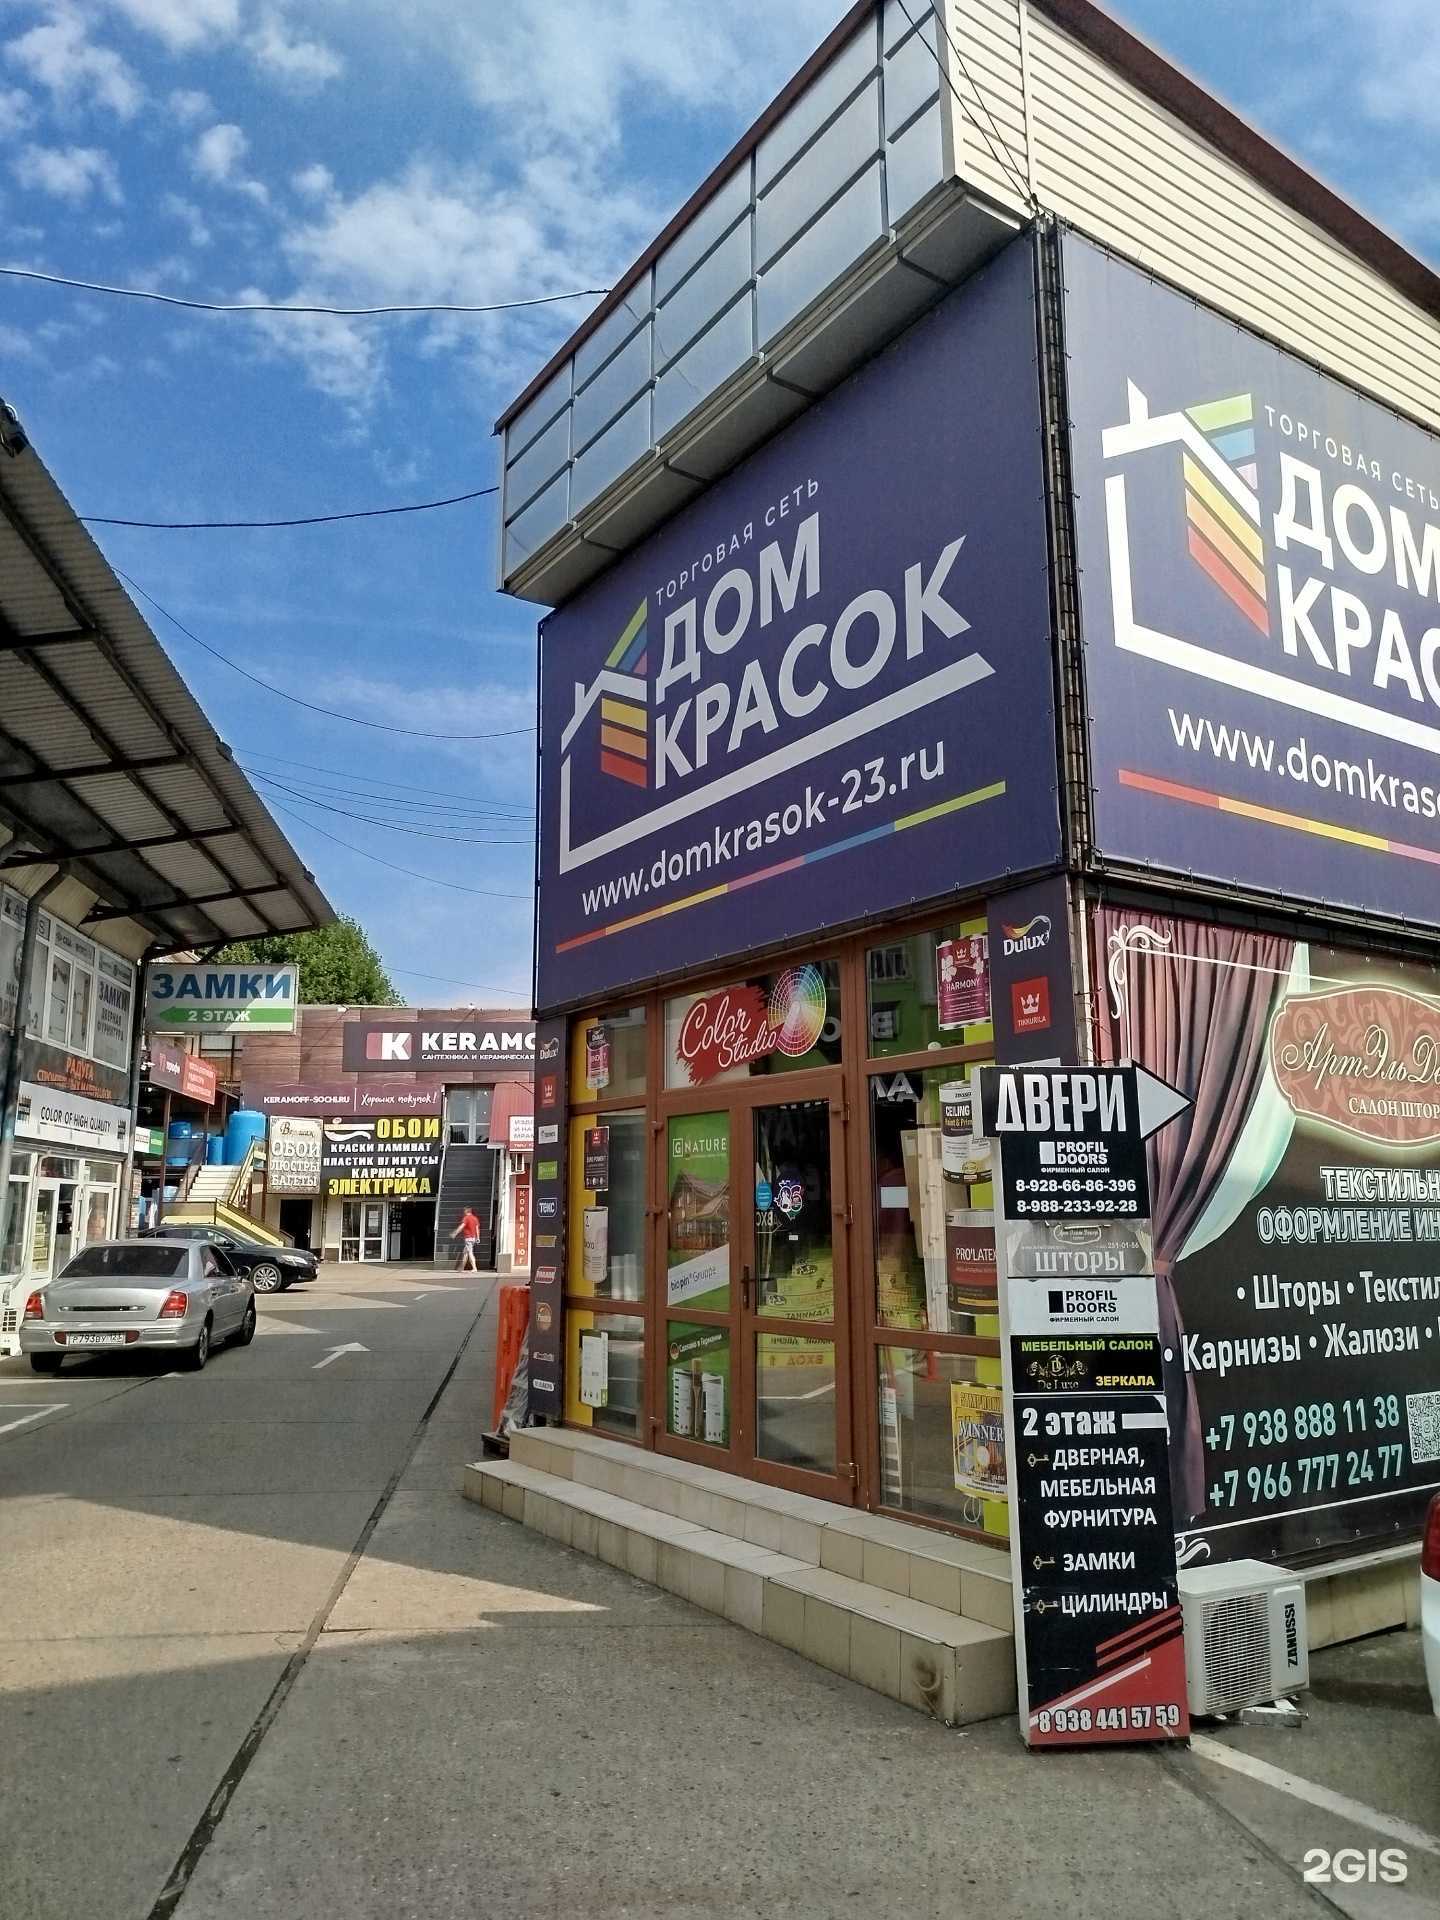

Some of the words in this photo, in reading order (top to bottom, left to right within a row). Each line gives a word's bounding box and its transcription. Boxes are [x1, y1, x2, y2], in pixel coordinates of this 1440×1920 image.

[1264, 405, 1381, 482] ТОРГОВАЯ
[1391, 471, 1440, 510] СЕТЬ
[655, 521, 753, 606] ТОРГОВАЯ
[764, 478, 819, 527] СЕТЬ
[656, 511, 821, 705] ДОМ
[655, 534, 972, 790] КРАСОК
[581, 740, 945, 916] www.domkrasok-23.ru
[1003, 935, 1047, 956] Dulux
[151, 973, 291, 999] ЗАМКИ
[945, 977, 981, 992] HARMONY
[98, 980, 129, 1012] ЗАМКИ
[187, 1010, 198, 1022] 2
[202, 1010, 251, 1022] ЭТАЖ
[681, 995, 752, 1058] Color
[1017, 1015, 1047, 1027] TIKKURILA
[717, 1019, 778, 1068] Studio
[66, 1056, 95, 1080] РАДУГА
[263, 1096, 350, 1104] KERAMOFF-SOCHI.RU
[360, 1093, 395, 1106] Хороших
[397, 1093, 438, 1108] покупок!
[995, 1073, 1127, 1133] ДВЕРИ
[1349, 1097, 1398, 1117] САЛОН
[40, 1106, 62, 1122] COLOR
[64, 1110, 73, 1124] OF
[74, 1113, 88, 1128] HIGH
[89, 1116, 111, 1133] QUALITY
[945, 1105, 970, 1117] CEILING
[377, 1117, 440, 1139] ОБОИ
[271, 1139, 321, 1158] ОБОИ
[330, 1143, 375, 1153] КРАСКИ
[377, 1142, 431, 1152] ЛАМИНАТ
[684, 1137, 727, 1152] NATURE
[1056, 1141, 1109, 1153] PROFIL
[271, 1159, 321, 1172] ЛЮСТРЫ
[323, 1156, 374, 1167] ПЛАСТИК
[1056, 1152, 1108, 1165] DOORS
[271, 1175, 317, 1186] БАГЕТЫ
[351, 1167, 416, 1179] КАРНИЗЫ
[1040, 1166, 1086, 1174] ФИРМЕННЫЙ
[328, 1177, 431, 1196] ЭЛЕКТРИКА
[1015, 1178, 1137, 1193] 8-928-66-86-396
[1016, 1199, 1138, 1213] 8-988-233-92-28
[1257, 1206, 1414, 1244] ОФОРМЛЕНИЕ
[1034, 1250, 1125, 1274] ШТОРЫ
[1065, 1290, 1118, 1301] PROFIL
[1253, 1274, 1341, 1315] Шторы
[1066, 1301, 1117, 1314] DOORS
[1049, 1315, 1096, 1324] ФИРМЕННЫЙ
[1097, 1315, 1120, 1323] САЛОН
[1021, 1339, 1105, 1352] МЕБЕЛЬНЫЙ
[1108, 1340, 1154, 1350] САЛОН
[1182, 1334, 1301, 1377] Карнизы
[1322, 1323, 1419, 1358] Жалюзи
[1095, 1375, 1156, 1387] ЗЕРКАЛА
[959, 1420, 1005, 1442] WINNER
[1022, 1407, 1039, 1437] 2
[1044, 1409, 1117, 1437] этаж
[1205, 1414, 1236, 1451] +7
[1242, 1408, 1288, 1448] 938
[1294, 1402, 1337, 1440] 888
[1342, 1398, 1367, 1433] 11
[1373, 1394, 1400, 1429] 38
[1052, 1447, 1146, 1471] ДВЕРНАЯ,
[1209, 1469, 1239, 1508] +7
[1246, 1461, 1292, 1503] 966
[1297, 1453, 1340, 1494] 777
[1346, 1449, 1374, 1486] 24
[1377, 1443, 1403, 1480] 77
[1040, 1476, 1156, 1498] МЕБЕЛЬНАЯ
[1043, 1507, 1157, 1530] ФУРНИТУРА
[1062, 1551, 1136, 1572] ЗАМКИ
[1060, 1591, 1168, 1618] ЦИЛИНДРЫ
[1287, 1602, 1296, 1669] ZANUSSI
[1038, 1709, 1052, 1733] 8
[1054, 1707, 1093, 1732] 938
[1094, 1706, 1127, 1731] 441
[1129, 1705, 1152, 1729] 57
[1154, 1703, 1180, 1727] 59
